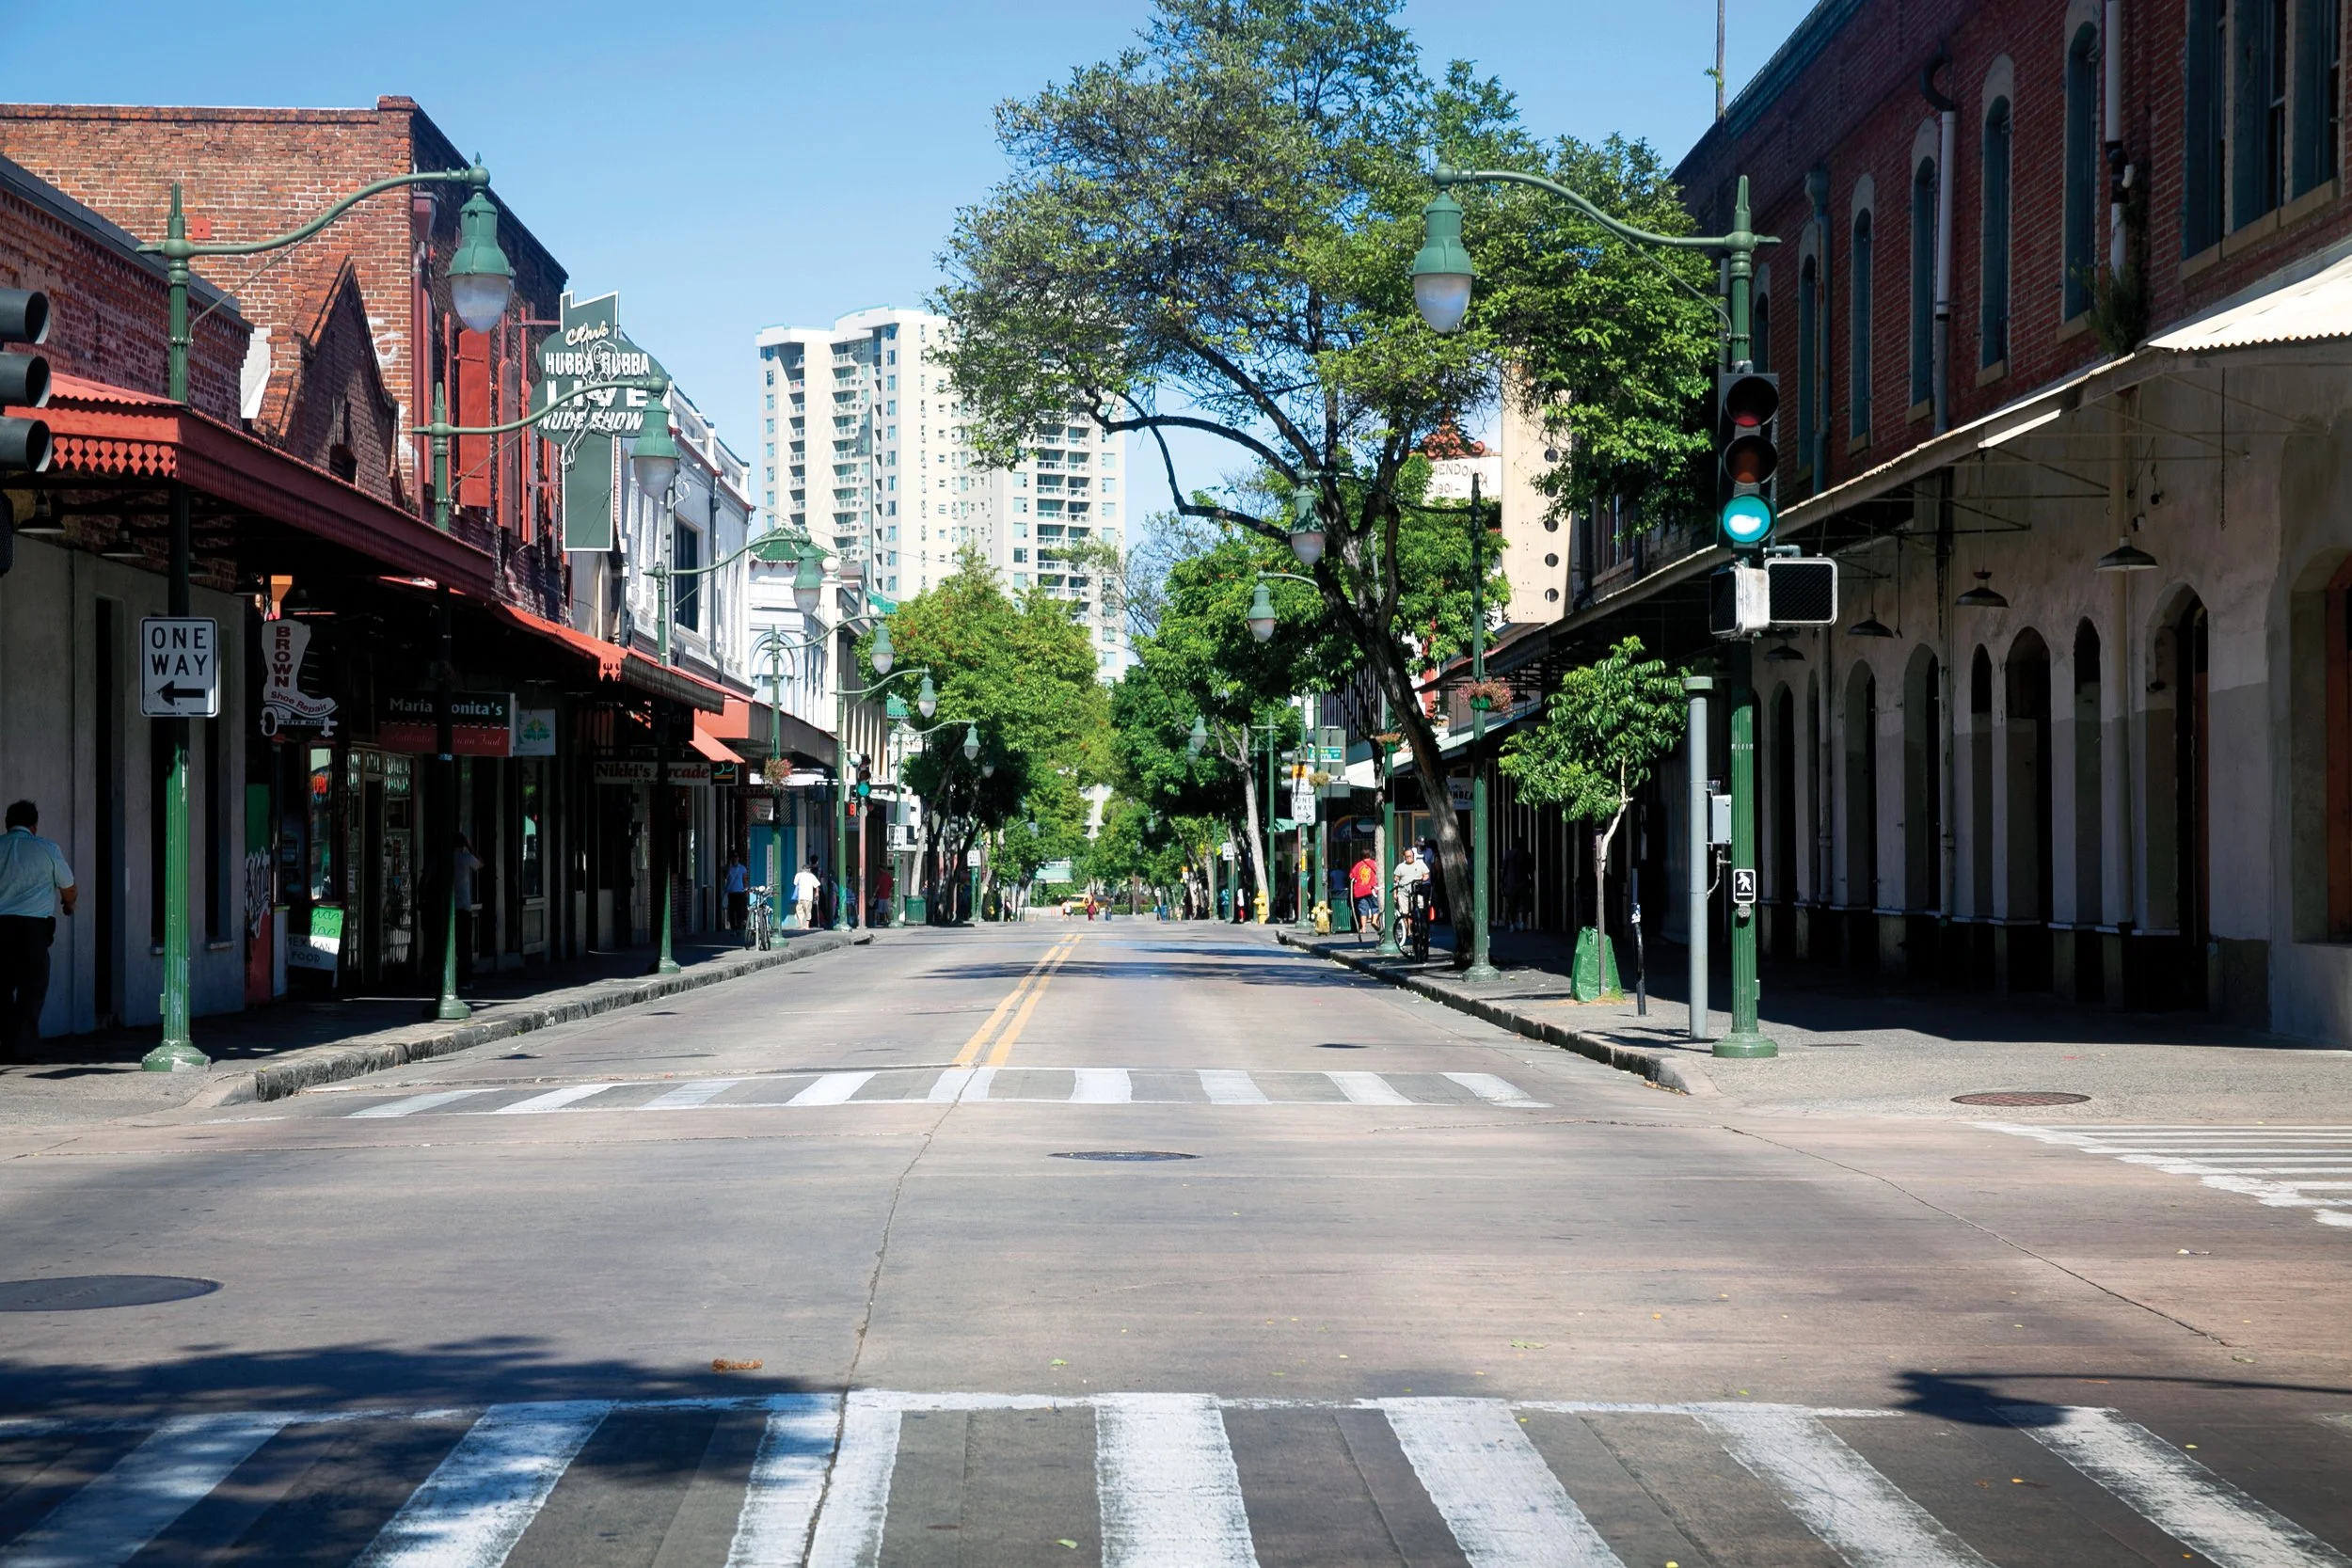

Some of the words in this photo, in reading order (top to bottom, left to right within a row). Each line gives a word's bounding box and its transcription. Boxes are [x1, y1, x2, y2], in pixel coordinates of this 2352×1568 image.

[545, 352, 595, 375] HUBBA
[547, 380, 649, 407] LIVE
[537, 411, 586, 431] NUDE
[589, 411, 644, 431] SHOW
[151, 626, 207, 649] ONE
[151, 654, 208, 675] WAY
[272, 626, 294, 688] BROWN
[270, 690, 295, 705] Shoe
[295, 700, 327, 714] Repair
[389, 697, 433, 713] Maria
[451, 700, 503, 716] onita's
[595, 763, 650, 779] Nikki's
[657, 764, 709, 780] rcade
[292, 951, 321, 963] FOOD
